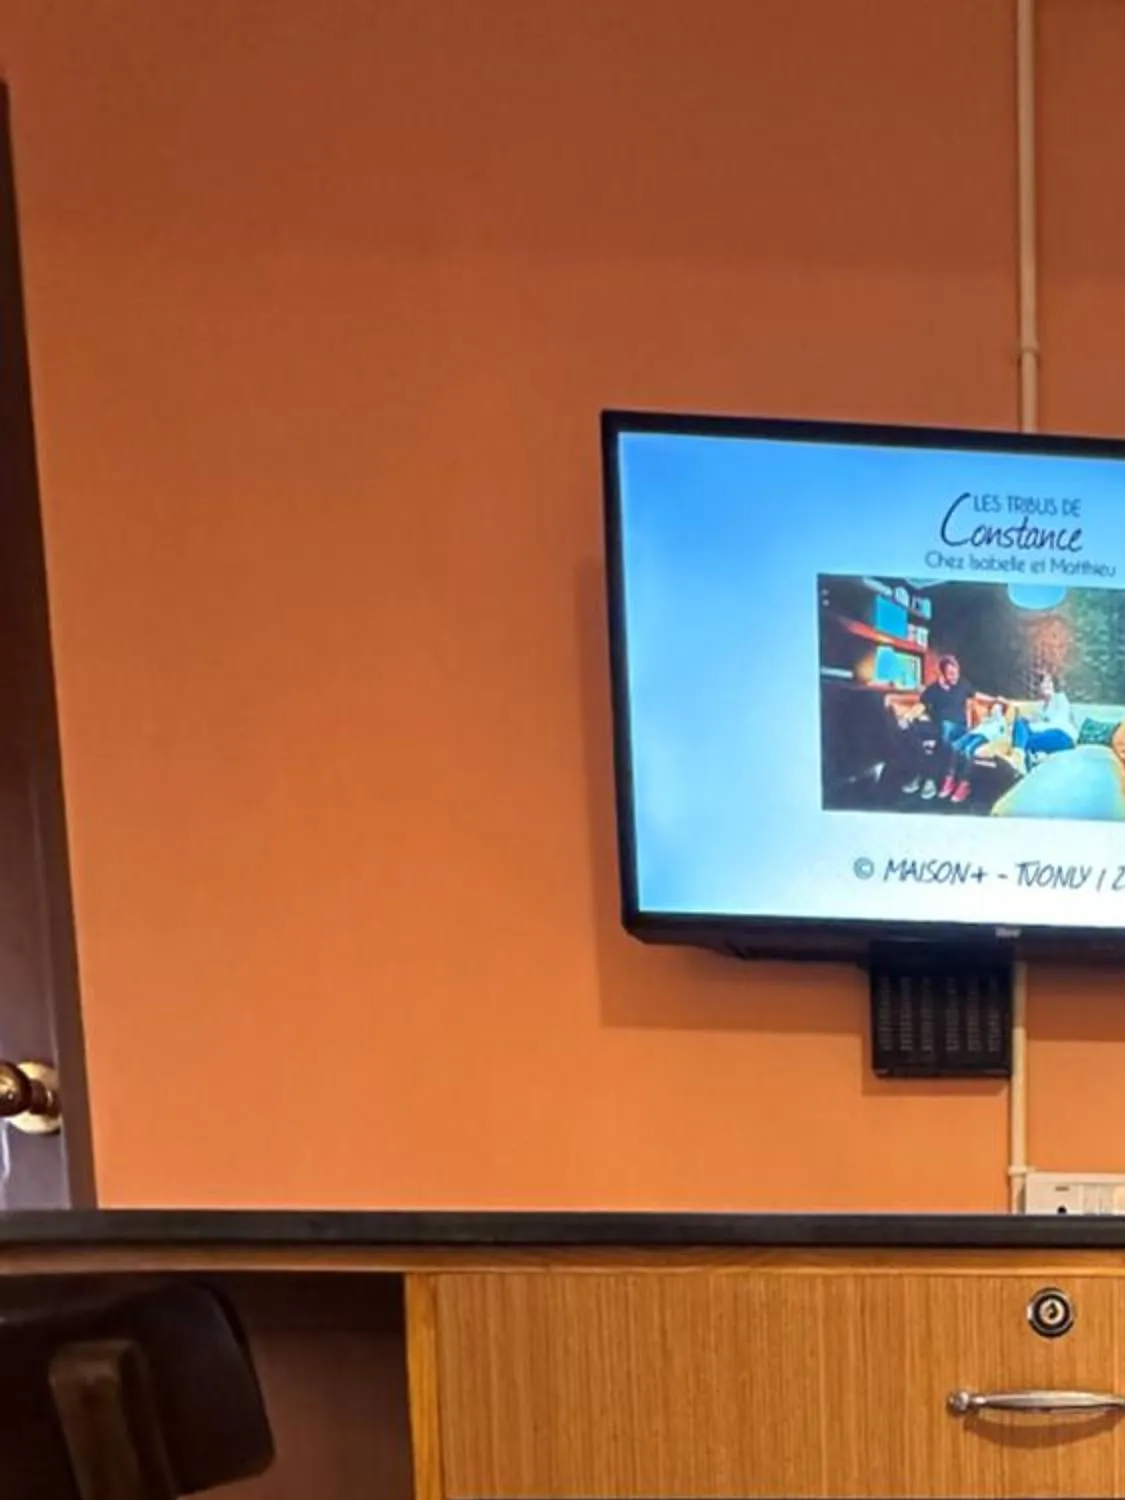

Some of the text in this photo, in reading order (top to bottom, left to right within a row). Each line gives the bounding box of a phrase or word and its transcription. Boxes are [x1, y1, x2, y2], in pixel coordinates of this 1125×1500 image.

[973, 494, 1082, 518] LES TRIBUS DE
[940, 492, 1083, 553] Constance
[924, 550, 1117, 578] Chez Isabelle et Matthieu
